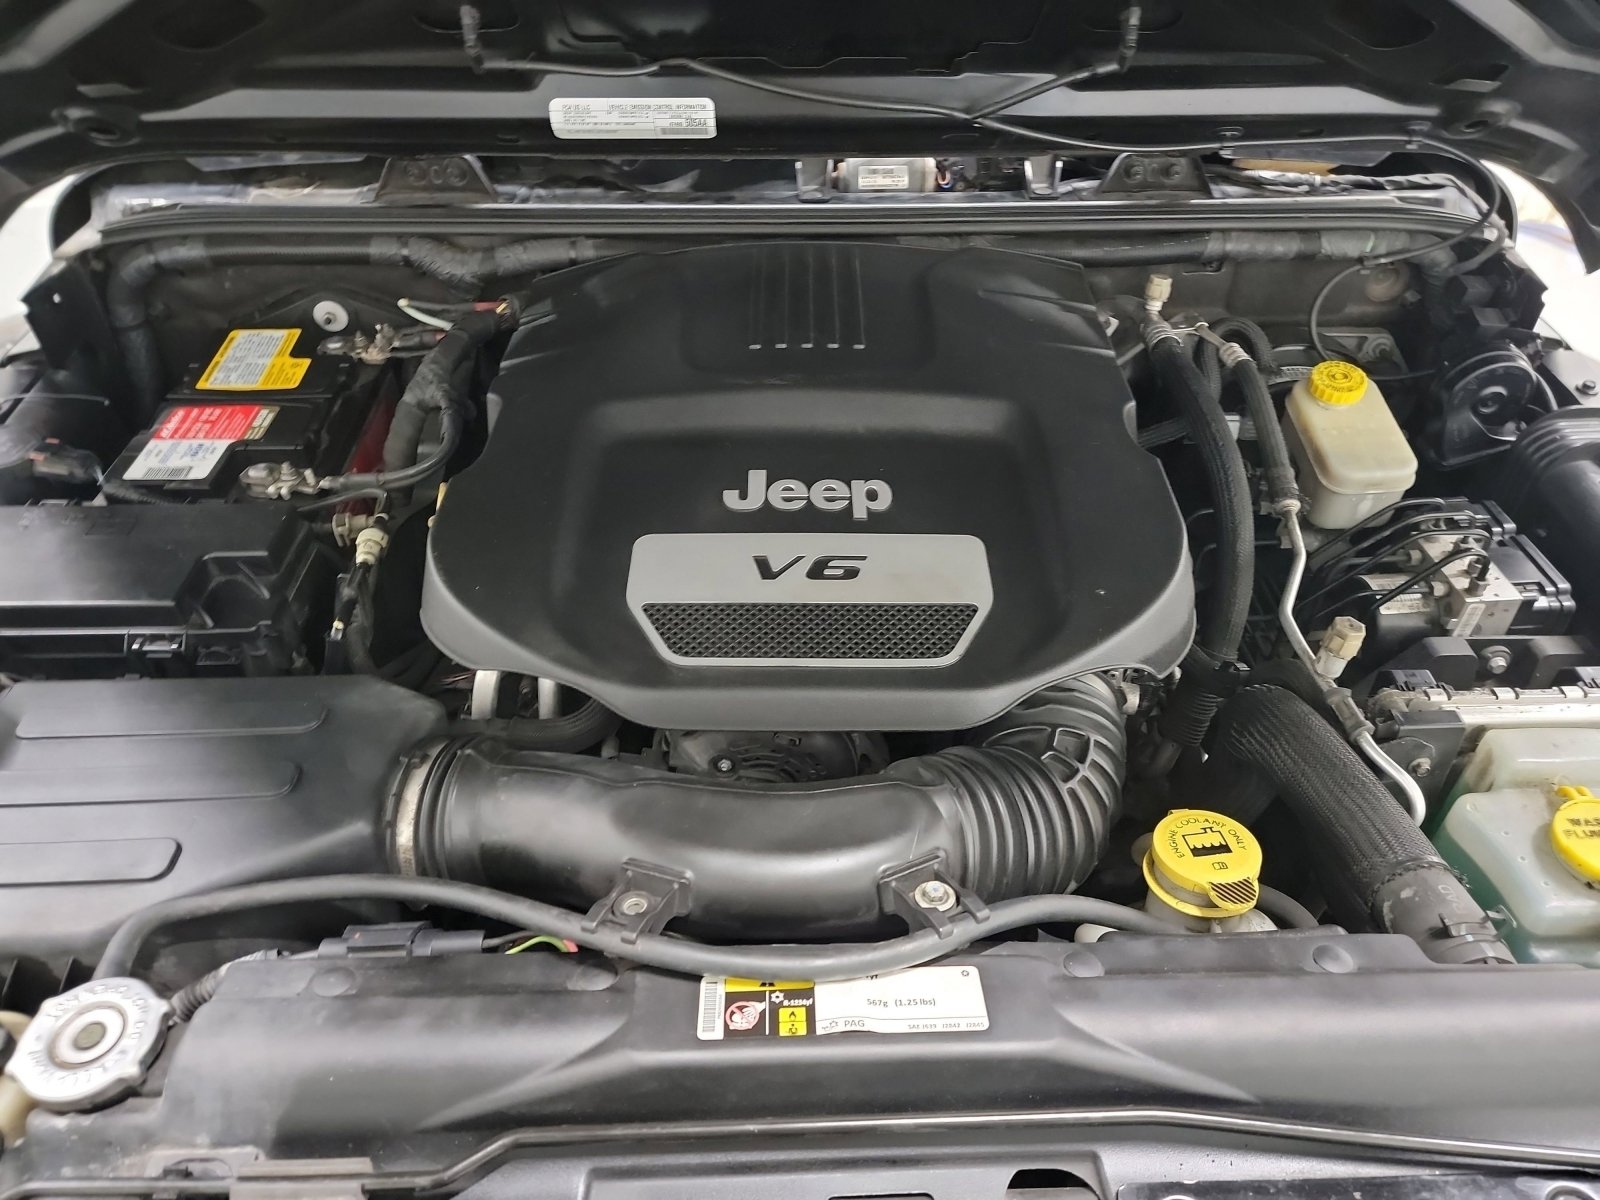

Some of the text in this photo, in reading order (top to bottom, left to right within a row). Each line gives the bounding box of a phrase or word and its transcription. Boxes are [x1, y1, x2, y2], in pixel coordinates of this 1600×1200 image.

[722, 469, 893, 521] Jeep
[751, 554, 868, 581] V6
[1168, 817, 1247, 858] ENGINE COOLANT ONLY
[867, 998, 936, 1008] 567g (1.25 lbs)
[844, 1019, 865, 1028] PAG
